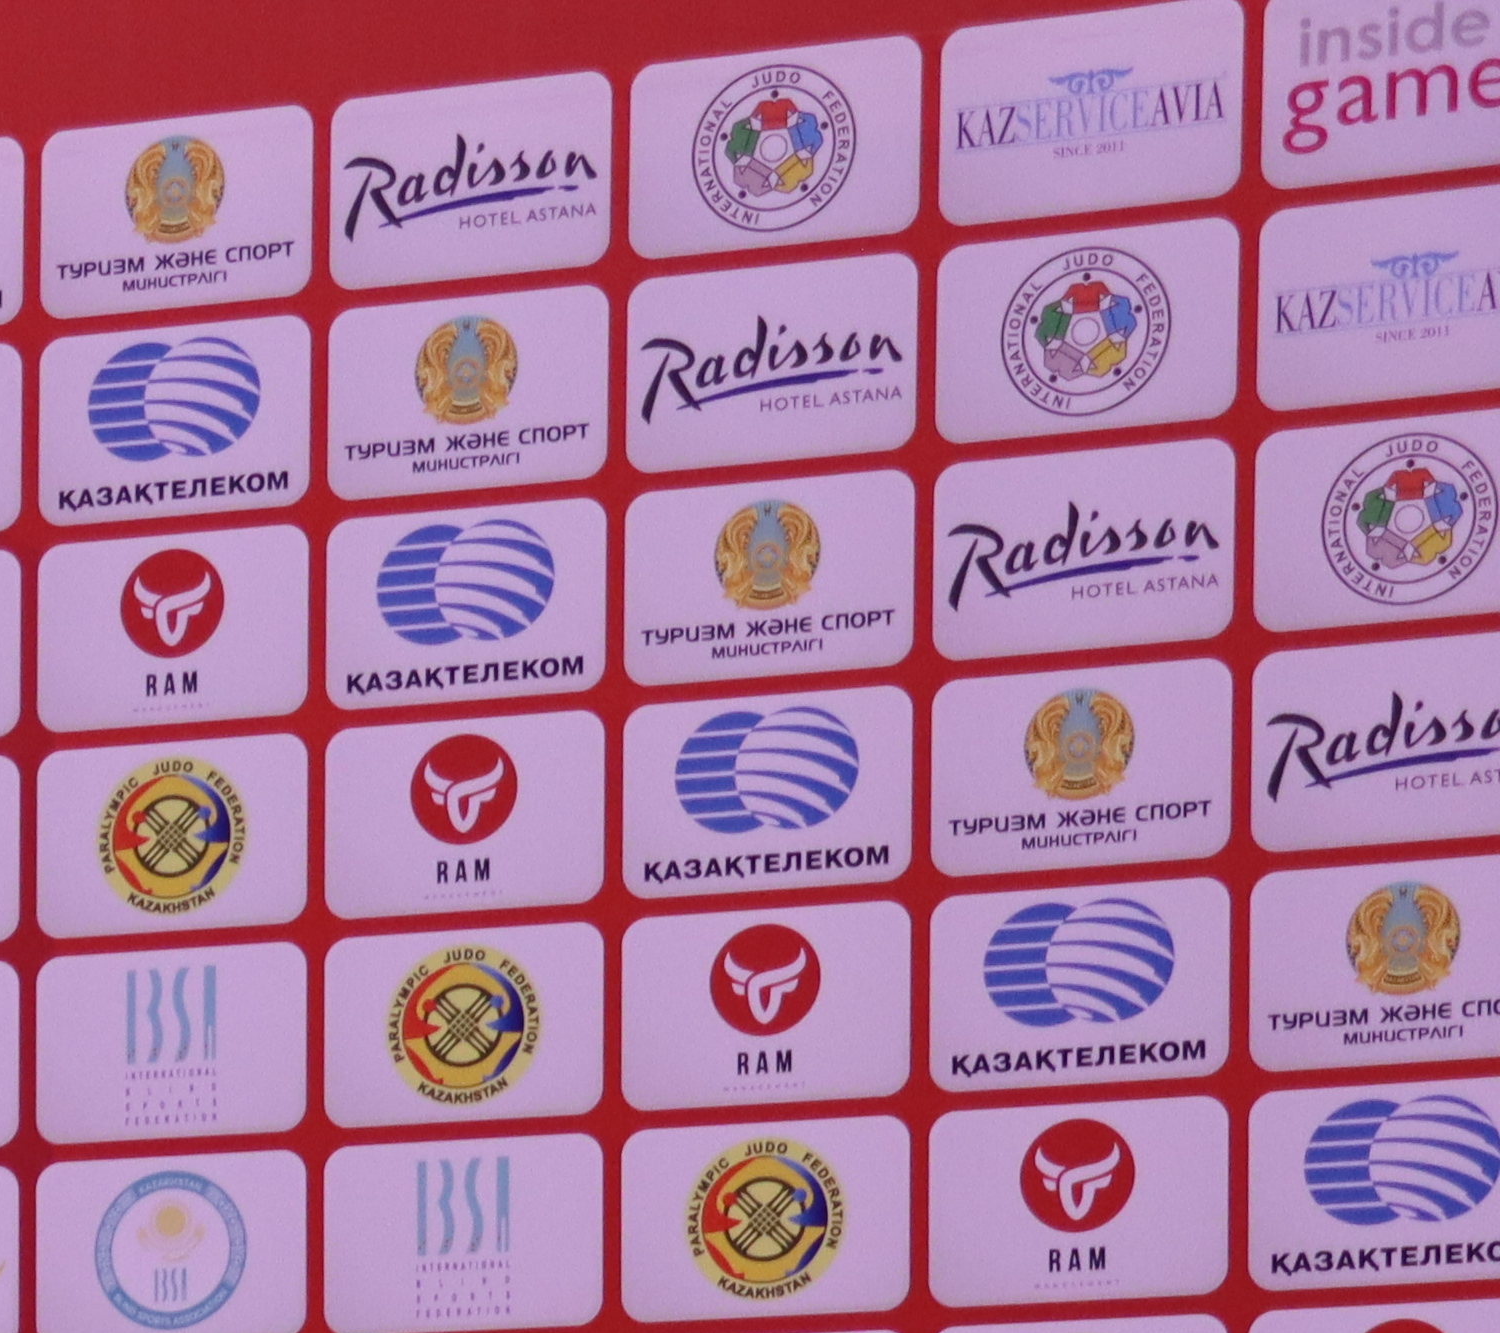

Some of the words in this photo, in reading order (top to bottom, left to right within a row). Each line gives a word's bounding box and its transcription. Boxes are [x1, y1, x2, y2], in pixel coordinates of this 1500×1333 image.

[1300, 2, 1491, 66] inside
[753, 70, 802, 88] JUDO
[344, 134, 597, 242] Radisson
[459, 211, 521, 229] HOTEL
[526, 202, 597, 222] ASTANA
[641, 315, 903, 424] Radisson
[760, 394, 823, 412] HOTEL
[829, 385, 902, 405] ASTANA
[58, 470, 289, 512] ҚАЗАҚТЕЛЕКОМ
[948, 501, 1220, 610] Radisson
[1071, 581, 1135, 599] HOTEL
[1143, 573, 1219, 592] ASTANA
[146, 670, 198, 697] RAM
[346, 655, 584, 695] ҚАЗАҚТЕЛЕКОМ
